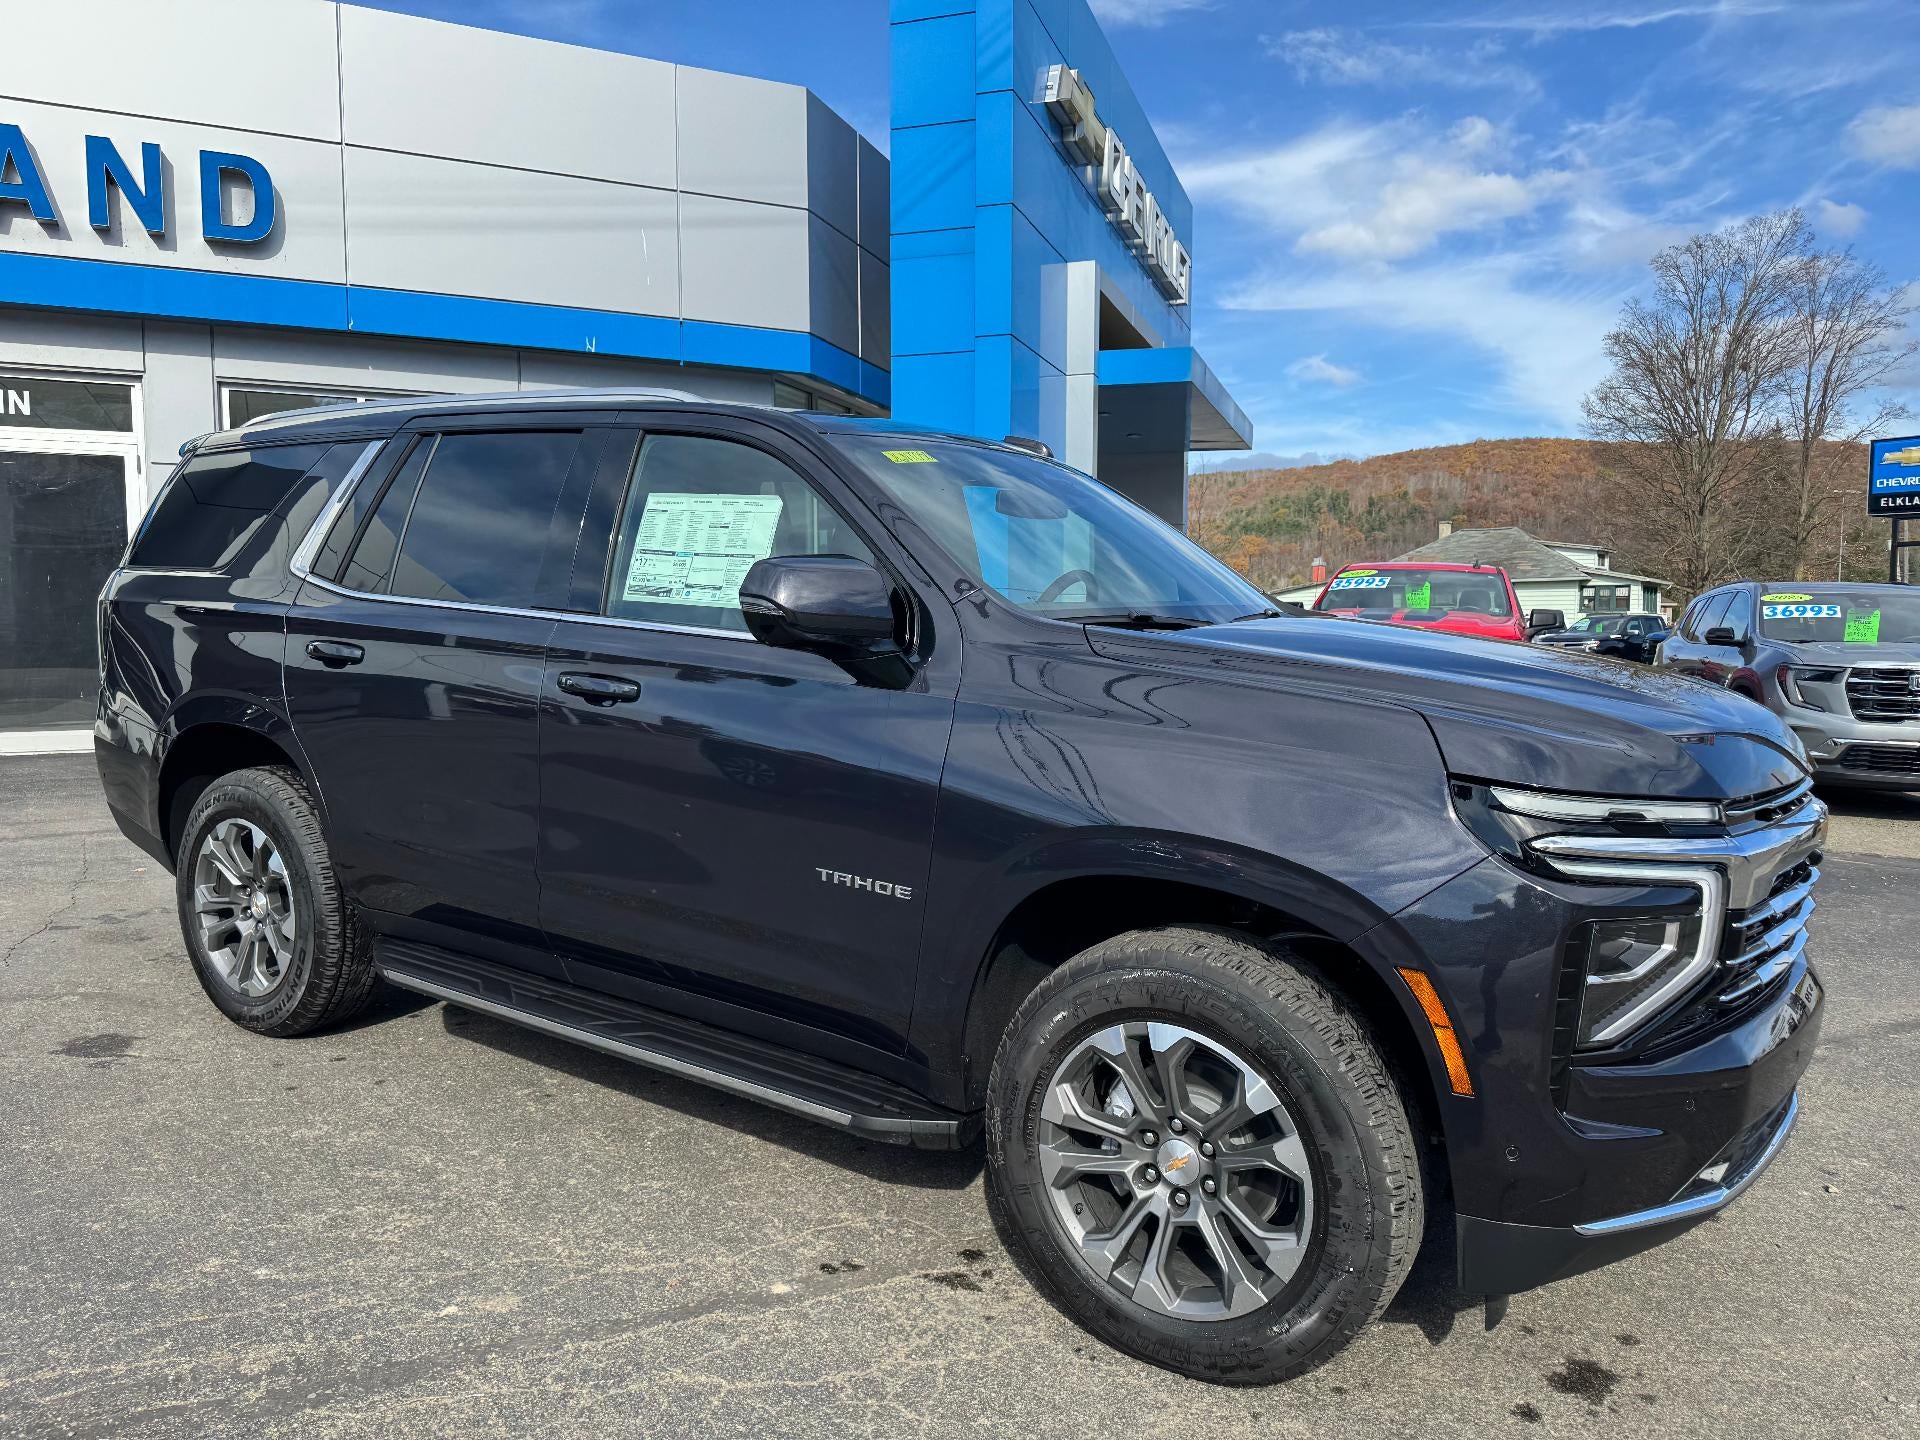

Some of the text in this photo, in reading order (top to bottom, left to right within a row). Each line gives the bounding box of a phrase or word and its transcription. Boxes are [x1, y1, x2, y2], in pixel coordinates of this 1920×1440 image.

[1330, 577, 1388, 590] 35995
[1764, 605, 1838, 617] 36995
[815, 867, 912, 900] TAHOE
